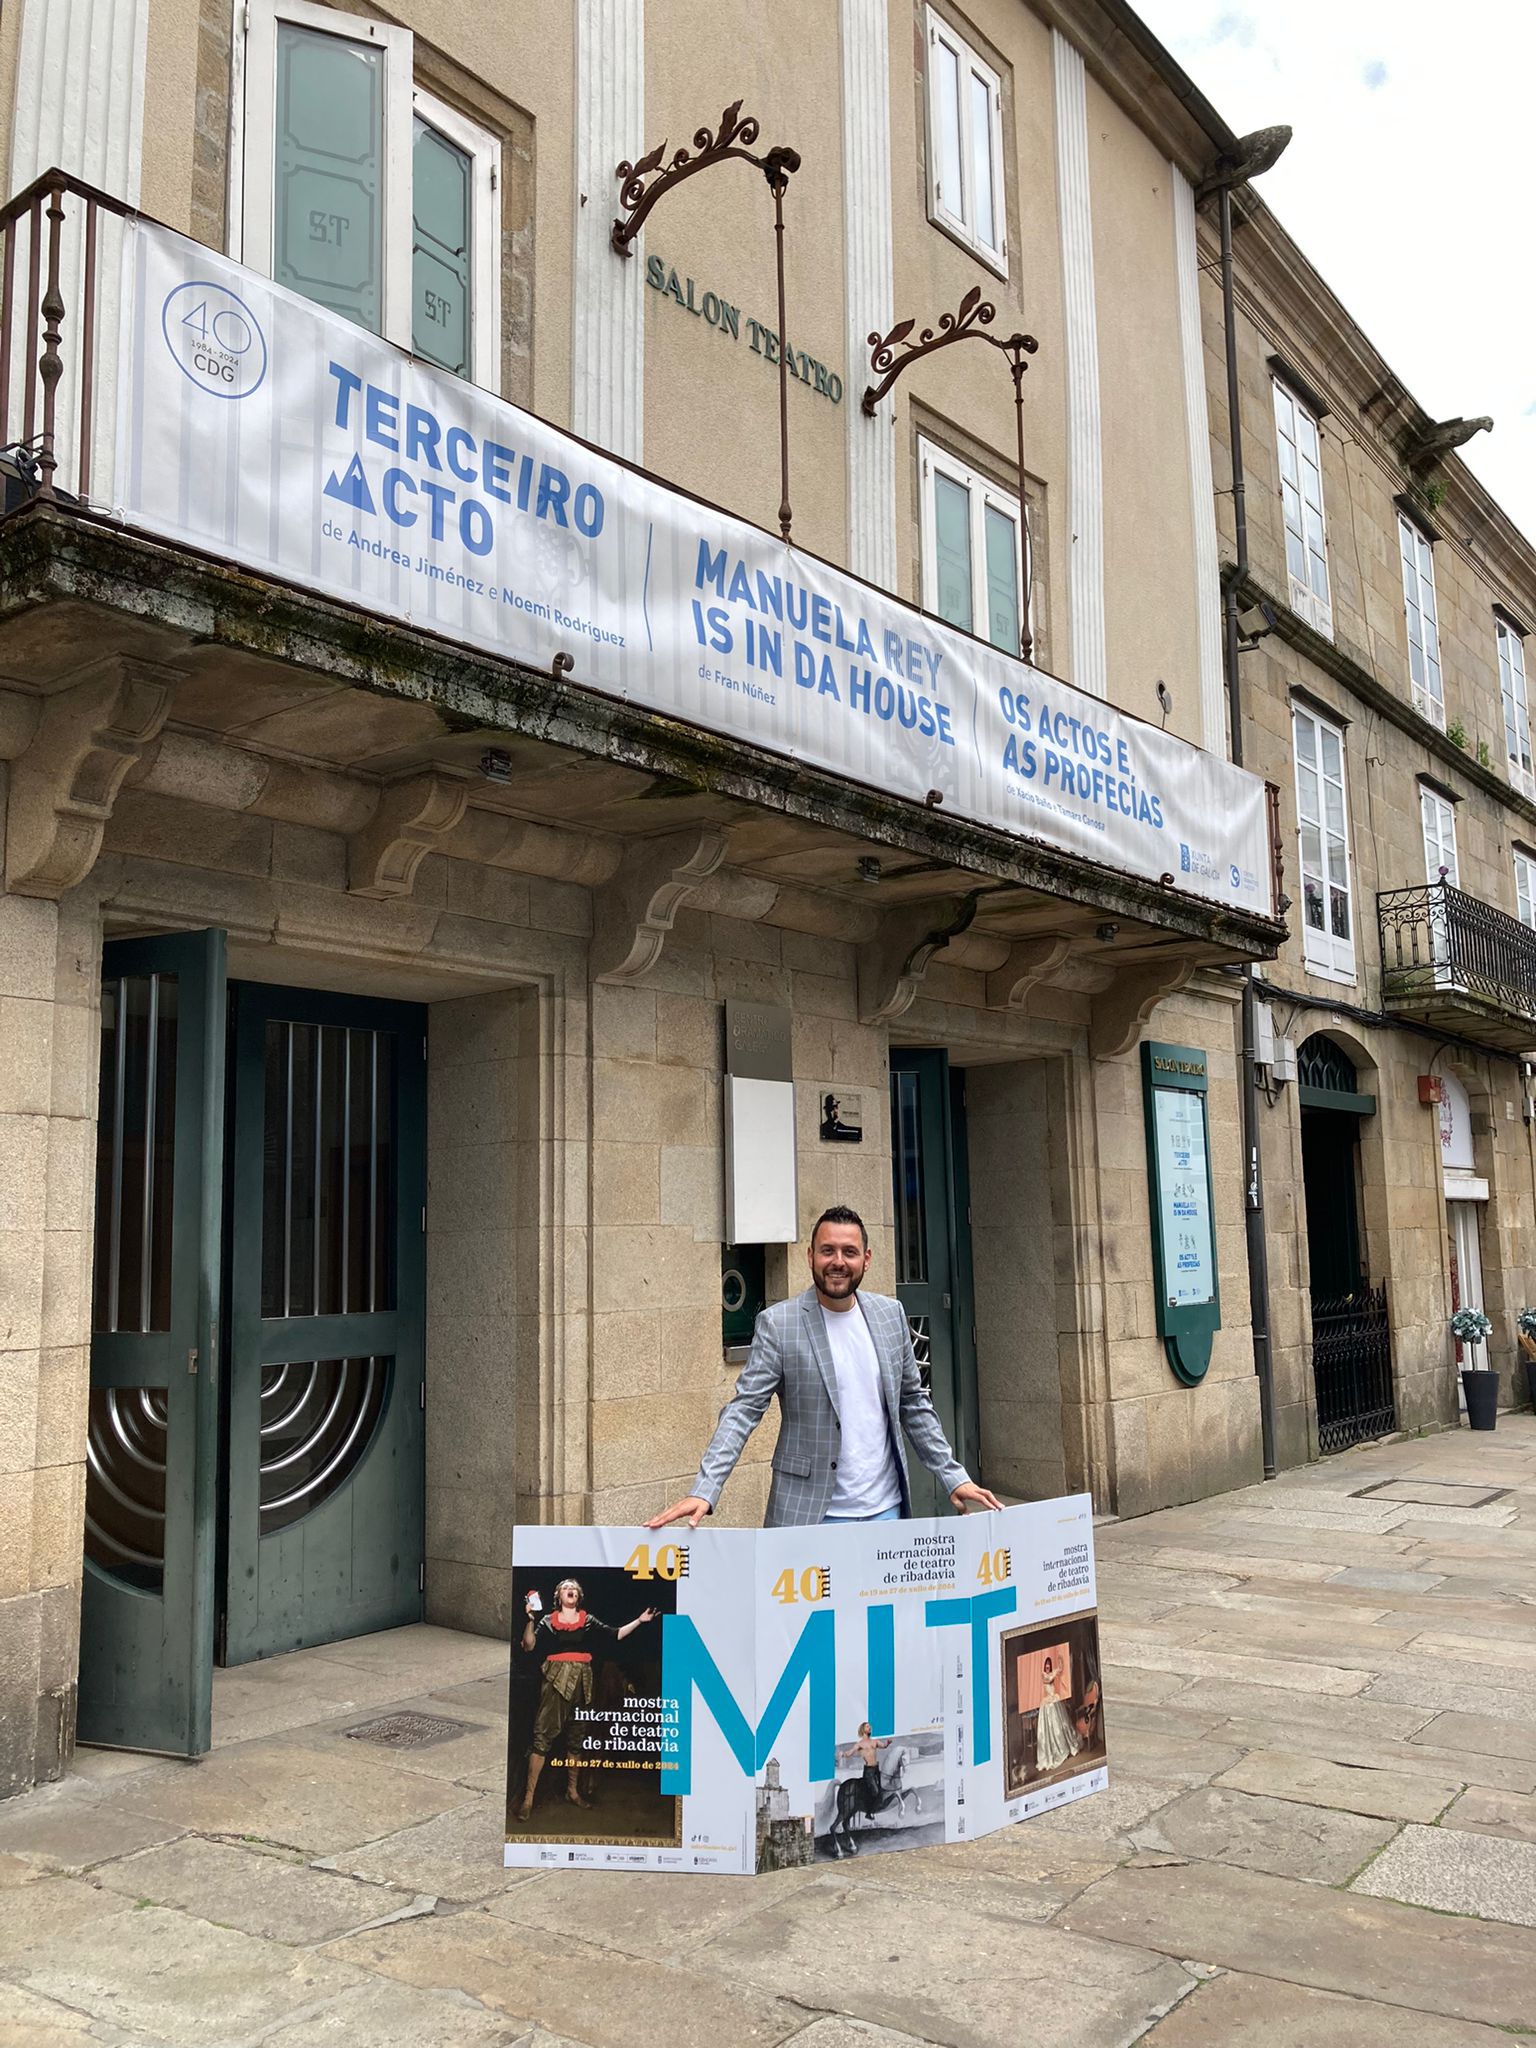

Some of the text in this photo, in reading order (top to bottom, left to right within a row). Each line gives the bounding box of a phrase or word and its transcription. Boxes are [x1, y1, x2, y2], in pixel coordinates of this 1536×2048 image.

[181, 301, 252, 354] 40
[646, 255, 842, 404] SALON TEATRO
[194, 353, 235, 383] CDG
[329, 360, 605, 538] TERCEIRO
[322, 519, 626, 648] de Andrea Jiménez e Noemi Rodríguez
[695, 538, 943, 692] MANUELA REY
[692, 599, 956, 746] IS IN DA HOUSE
[698, 664, 776, 706] de Fran Núñez
[999, 686, 1130, 776] OS ACTOS E
[1002, 733, 1164, 830] AS PROFECÍAS
[877, 1545, 955, 1561] internacional
[913, 1534, 955, 1547] mostra
[1064, 1543, 1088, 1556] mostra
[624, 1543, 681, 1581] 40
[676, 1545, 690, 1578] mit
[883, 1568, 956, 1584] de ribadavia
[903, 1557, 956, 1571] de teatro
[976, 1548, 1008, 1586] 40
[1003, 1546, 1011, 1577] mit
[1042, 1552, 1089, 1571] internacional
[1059, 1564, 1090, 1579] de teatro
[770, 1565, 823, 1604] 40
[818, 1565, 831, 1599] mit
[1048, 1574, 1090, 1593] de ribadavia
[574, 1707, 680, 1723] internacional
[623, 1696, 680, 1709] mostra
[582, 1736, 680, 1752] de ribadavia
[609, 1722, 680, 1738] de teatro
[550, 1758, 563, 1767] do
[564, 1758, 575, 1767] 19
[576, 1760, 589, 1768] ao
[589, 1759, 602, 1768] 27
[602, 1759, 615, 1769] de
[615, 1760, 641, 1769] xullo
[642, 1760, 654, 1770] de
